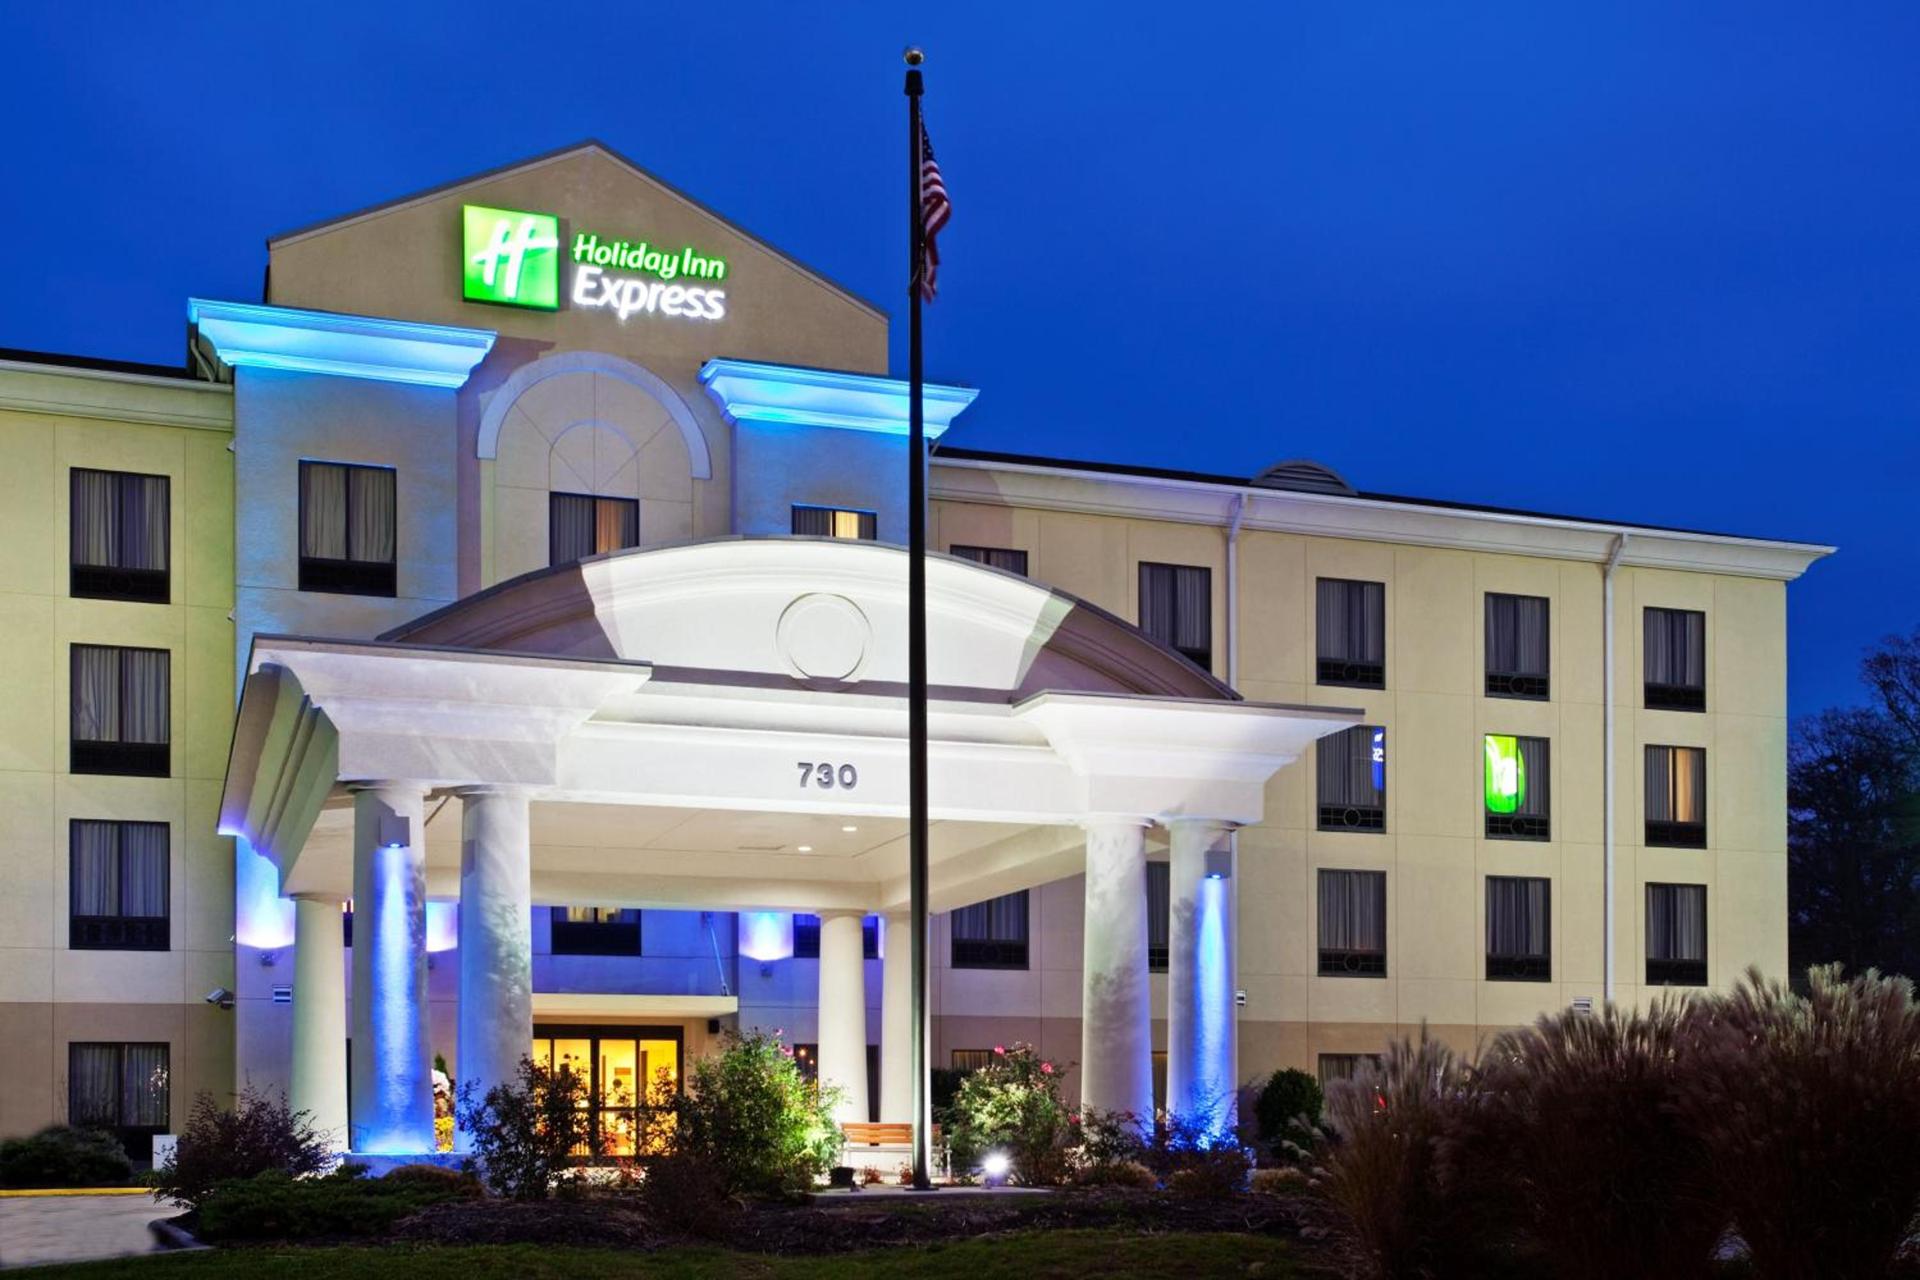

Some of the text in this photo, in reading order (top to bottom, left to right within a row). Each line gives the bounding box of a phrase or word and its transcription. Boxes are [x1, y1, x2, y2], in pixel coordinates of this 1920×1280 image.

[573, 234, 725, 280] Holiday Inn
[572, 265, 726, 320] Express
[797, 762, 858, 790] 730
